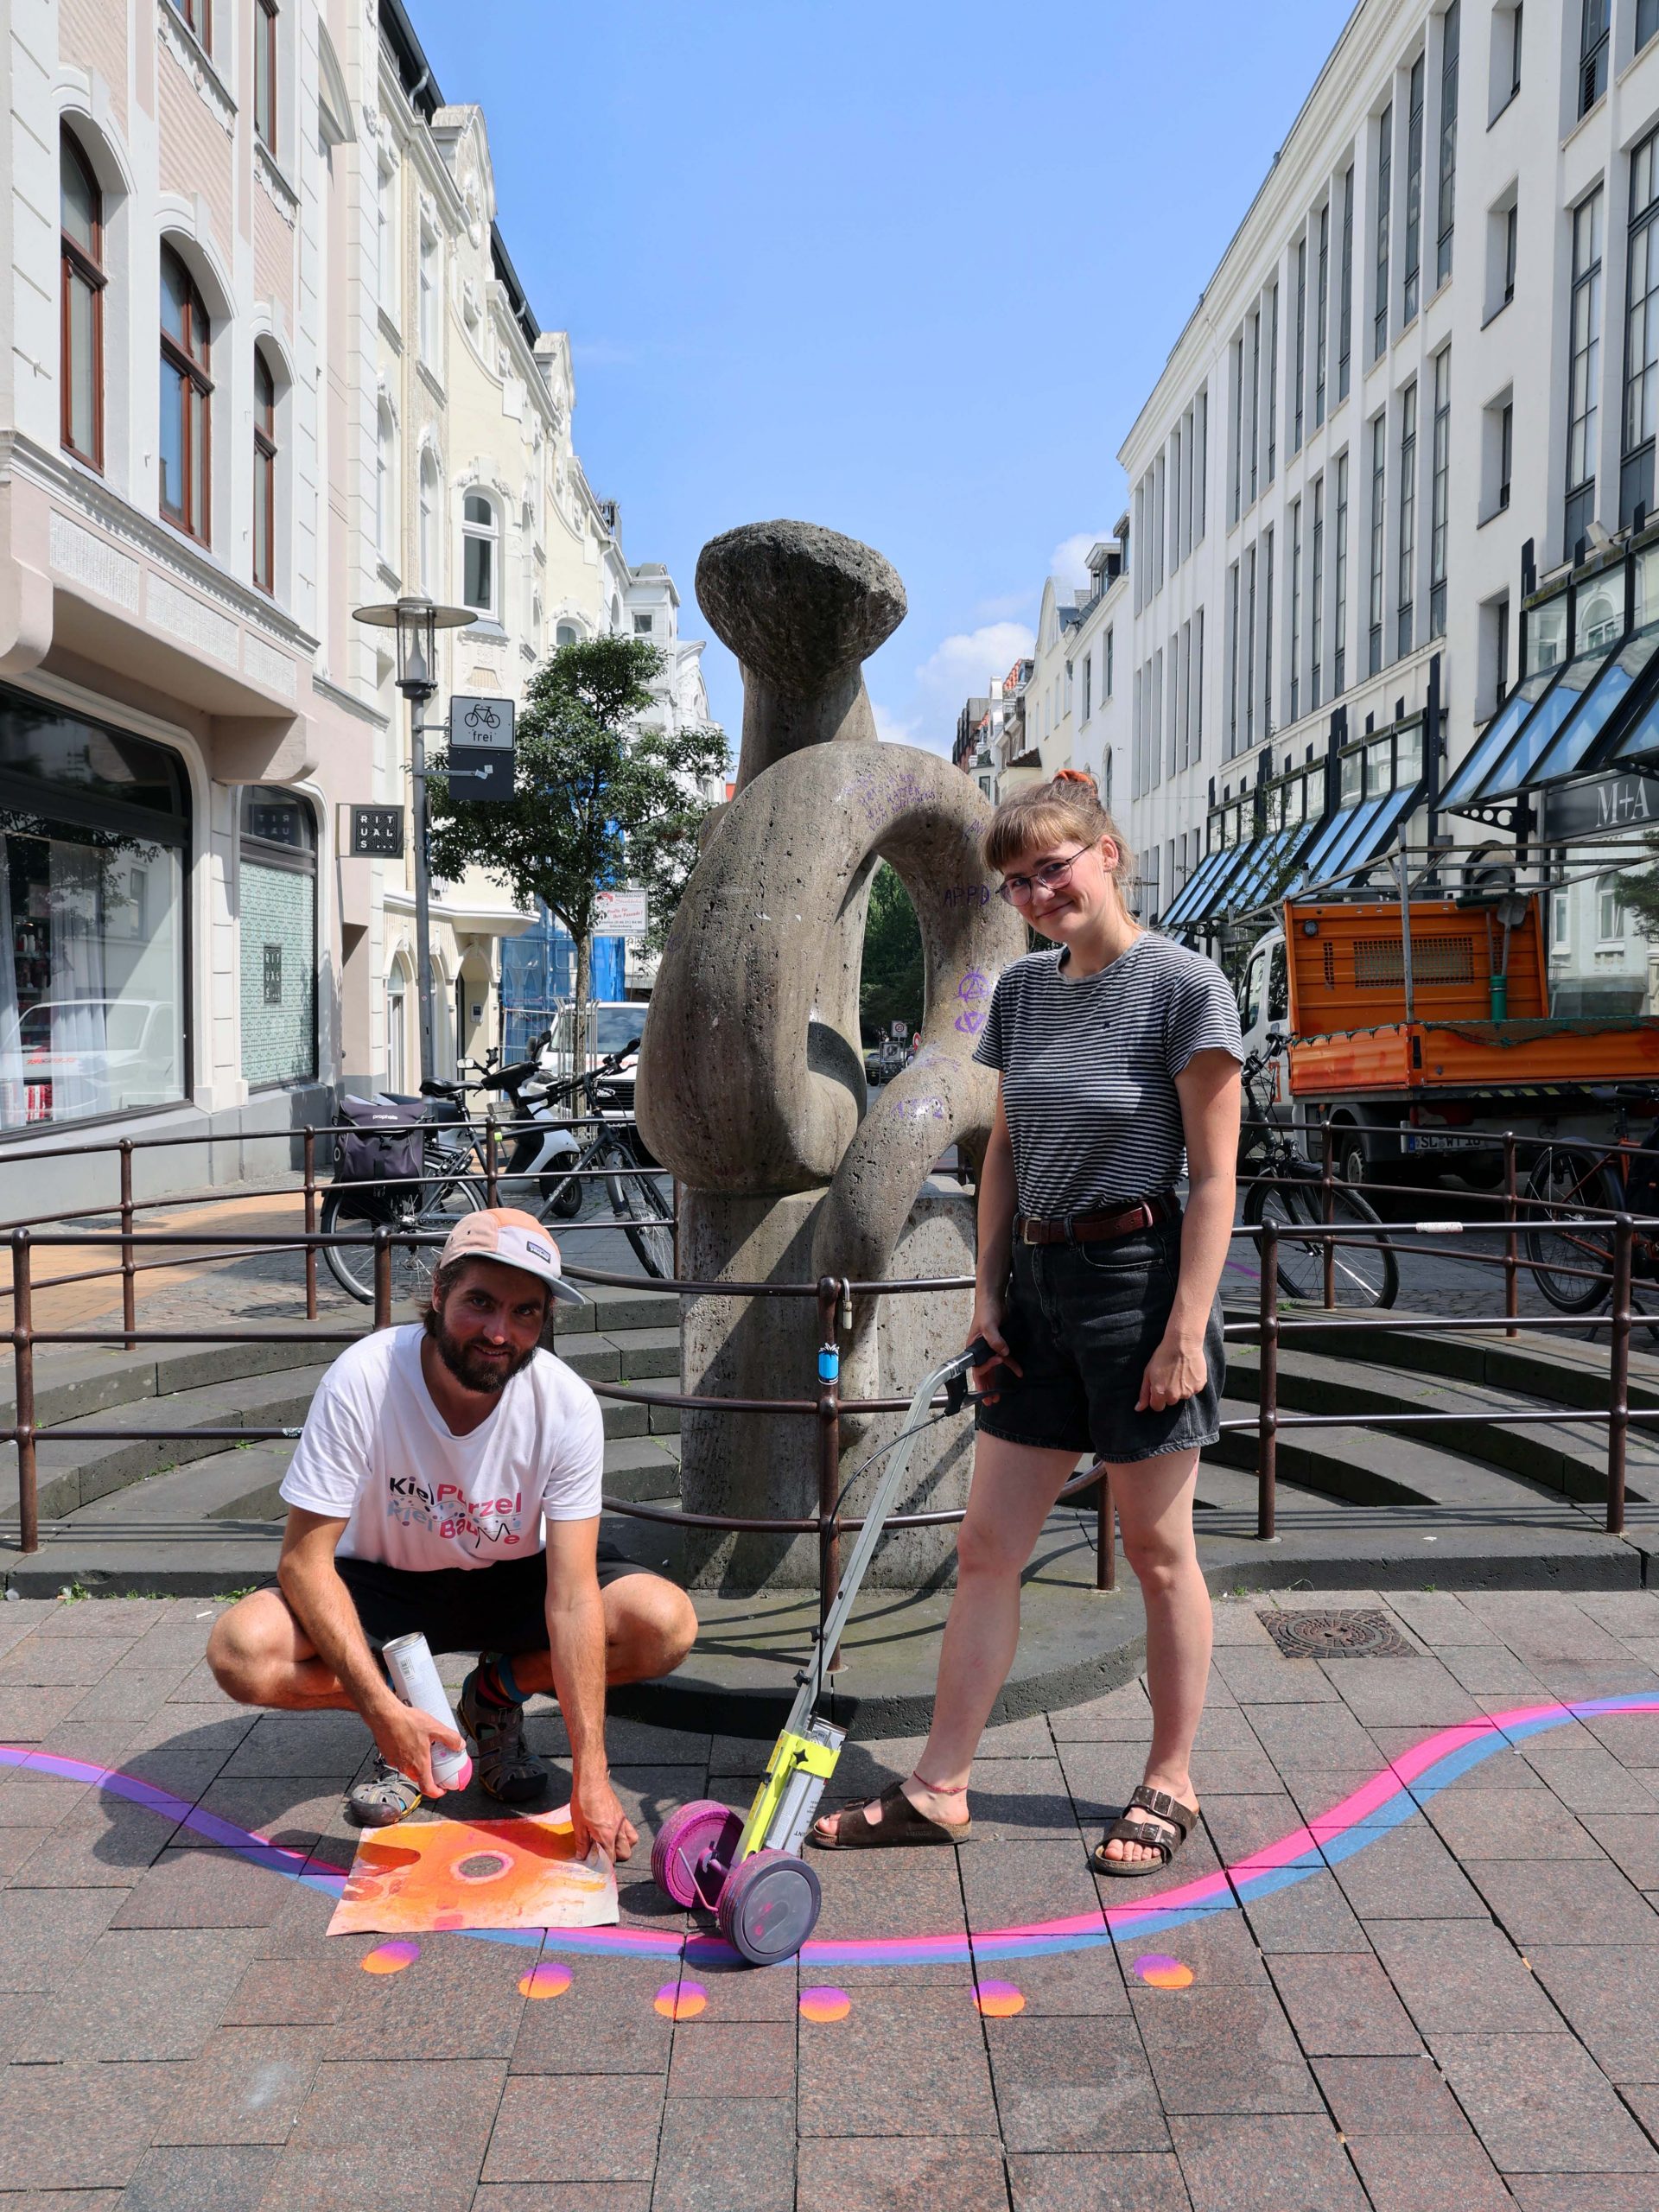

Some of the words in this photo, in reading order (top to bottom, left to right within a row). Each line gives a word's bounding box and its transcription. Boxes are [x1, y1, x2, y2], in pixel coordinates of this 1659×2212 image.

[473, 731, 493, 742] frei
[1596, 777, 1650, 828] M+A
[944, 884, 990, 907] APPD
[390, 1476, 435, 1506] Kiel
[437, 1484, 522, 1517] Purzel
